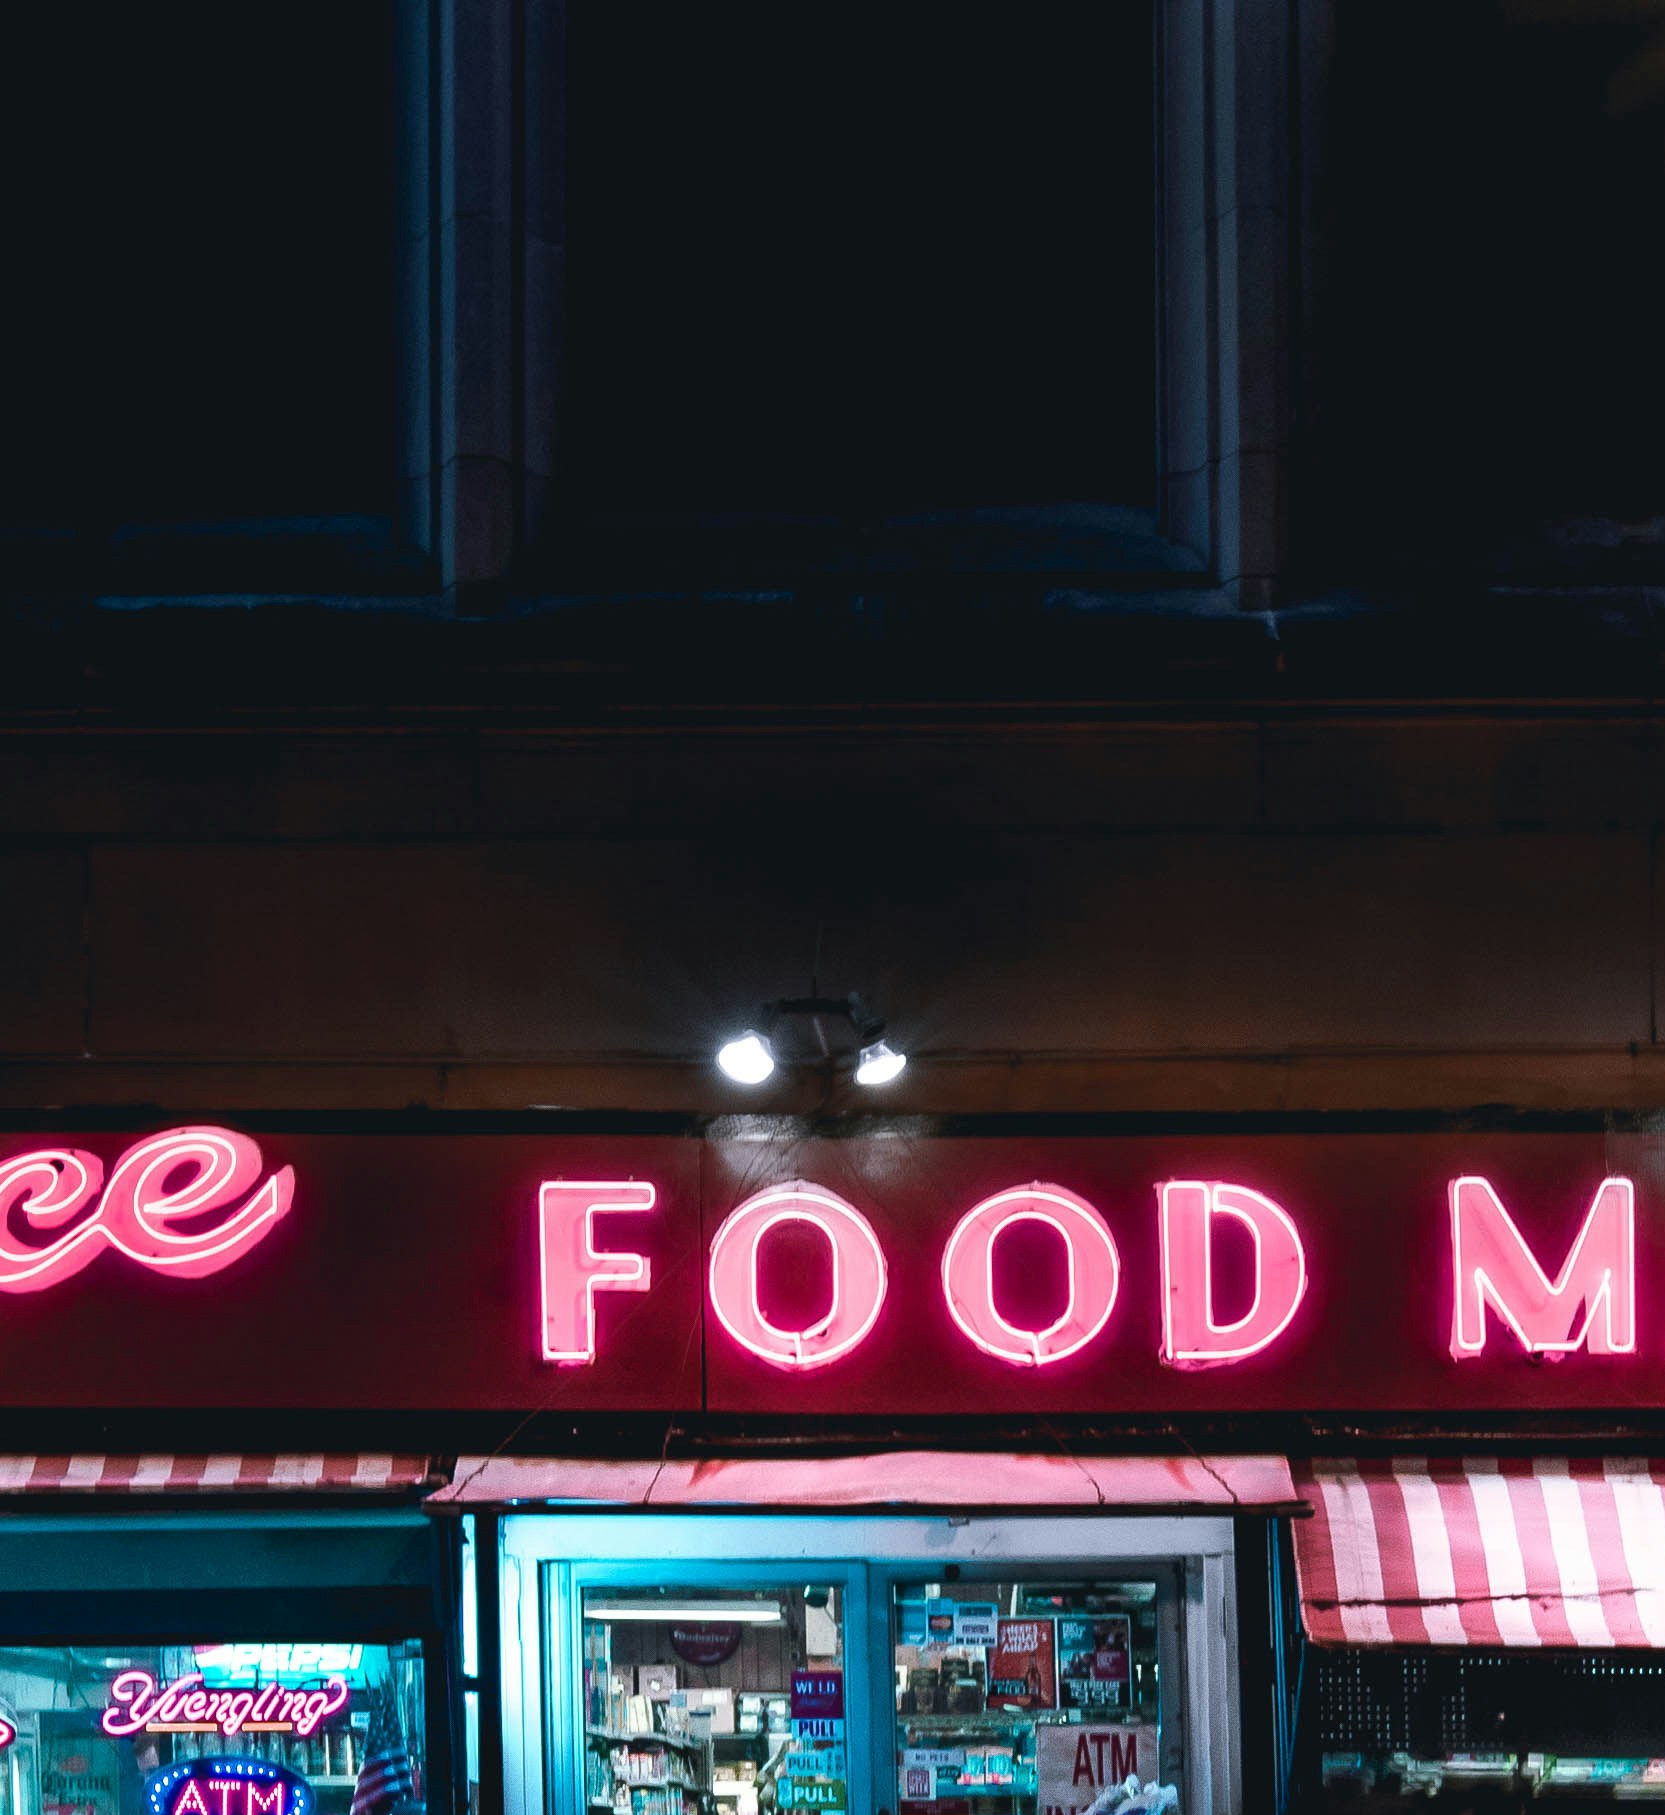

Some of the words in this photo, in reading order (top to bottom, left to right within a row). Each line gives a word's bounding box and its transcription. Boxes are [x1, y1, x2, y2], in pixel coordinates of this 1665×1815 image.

[538, 1179, 1308, 1372] FOOD
[102, 1671, 348, 1736] Yuengling
[798, 1719, 835, 1737] PULL
[788, 1757, 821, 1771] PULL
[1072, 1732, 1138, 1787] ATM
[794, 1786, 838, 1803] PULL
